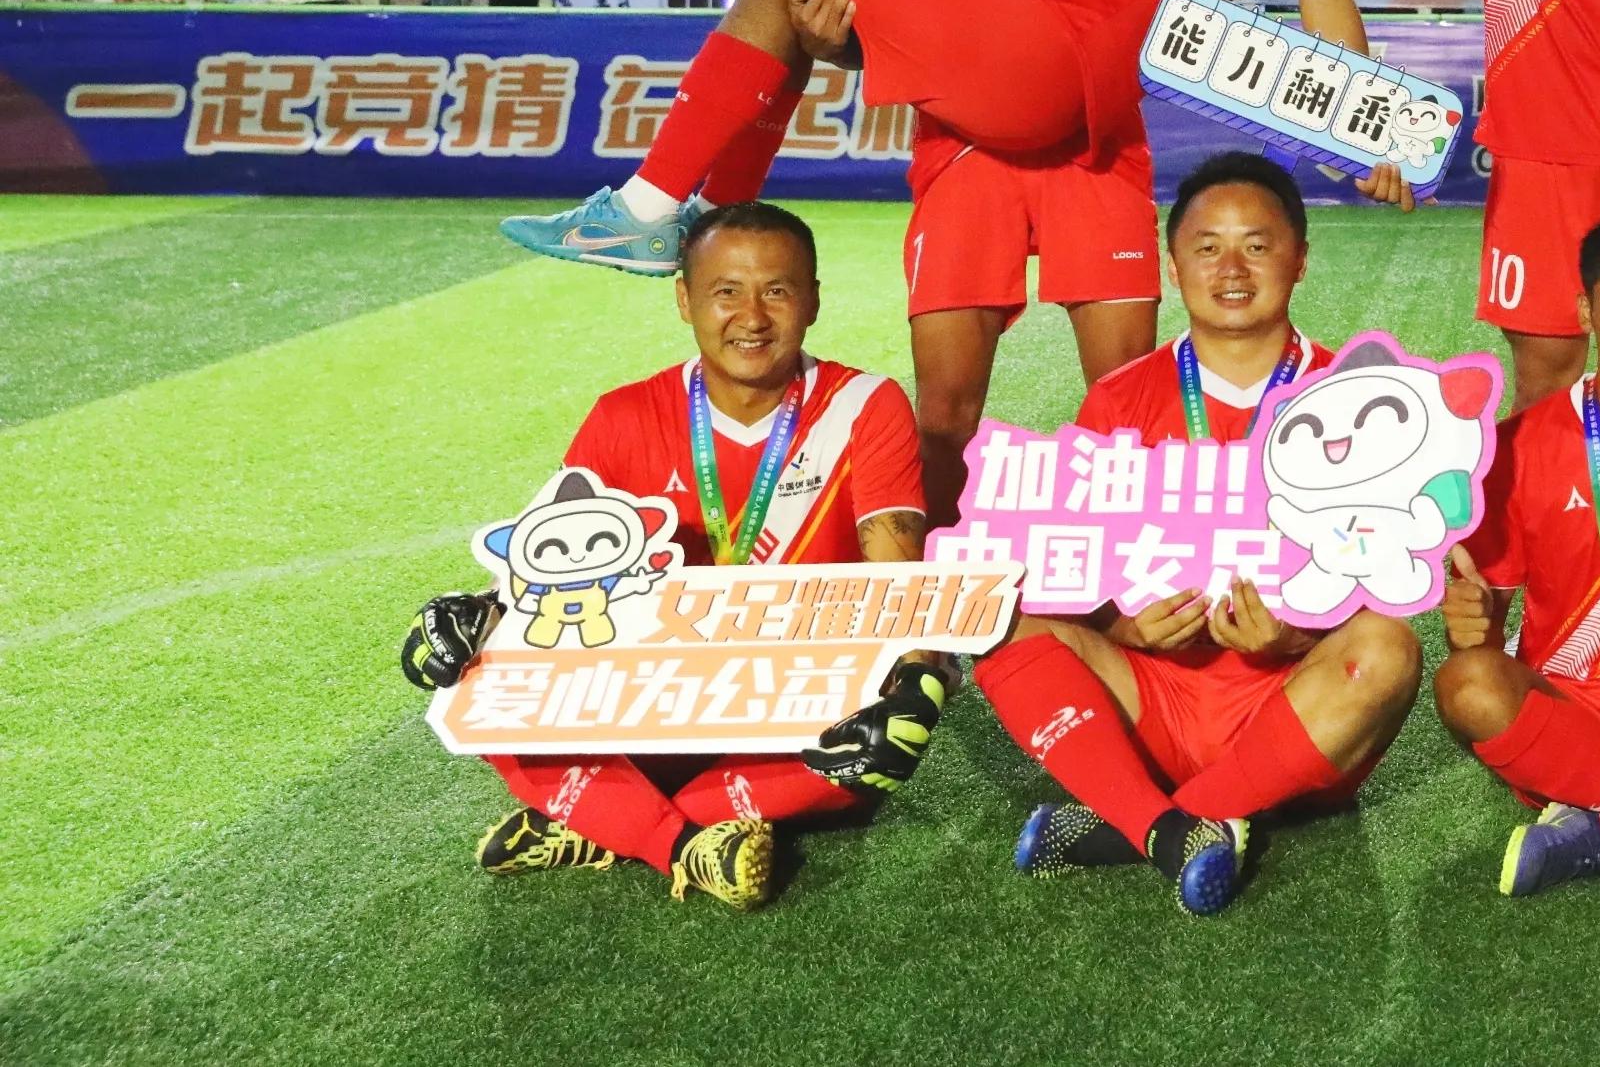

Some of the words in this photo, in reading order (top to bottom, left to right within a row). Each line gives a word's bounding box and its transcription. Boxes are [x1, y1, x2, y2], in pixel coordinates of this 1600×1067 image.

[68, 54, 578, 159] 一起竞猜
[1160, 15, 1392, 142] 能力翻番
[1112, 251, 1144, 260] LOOKS
[1489, 246, 1525, 310] 10
[973, 429, 1250, 515] 加油!!!
[640, 573, 1008, 645] 女足耀球场
[464, 659, 857, 730] 爱心为公益
